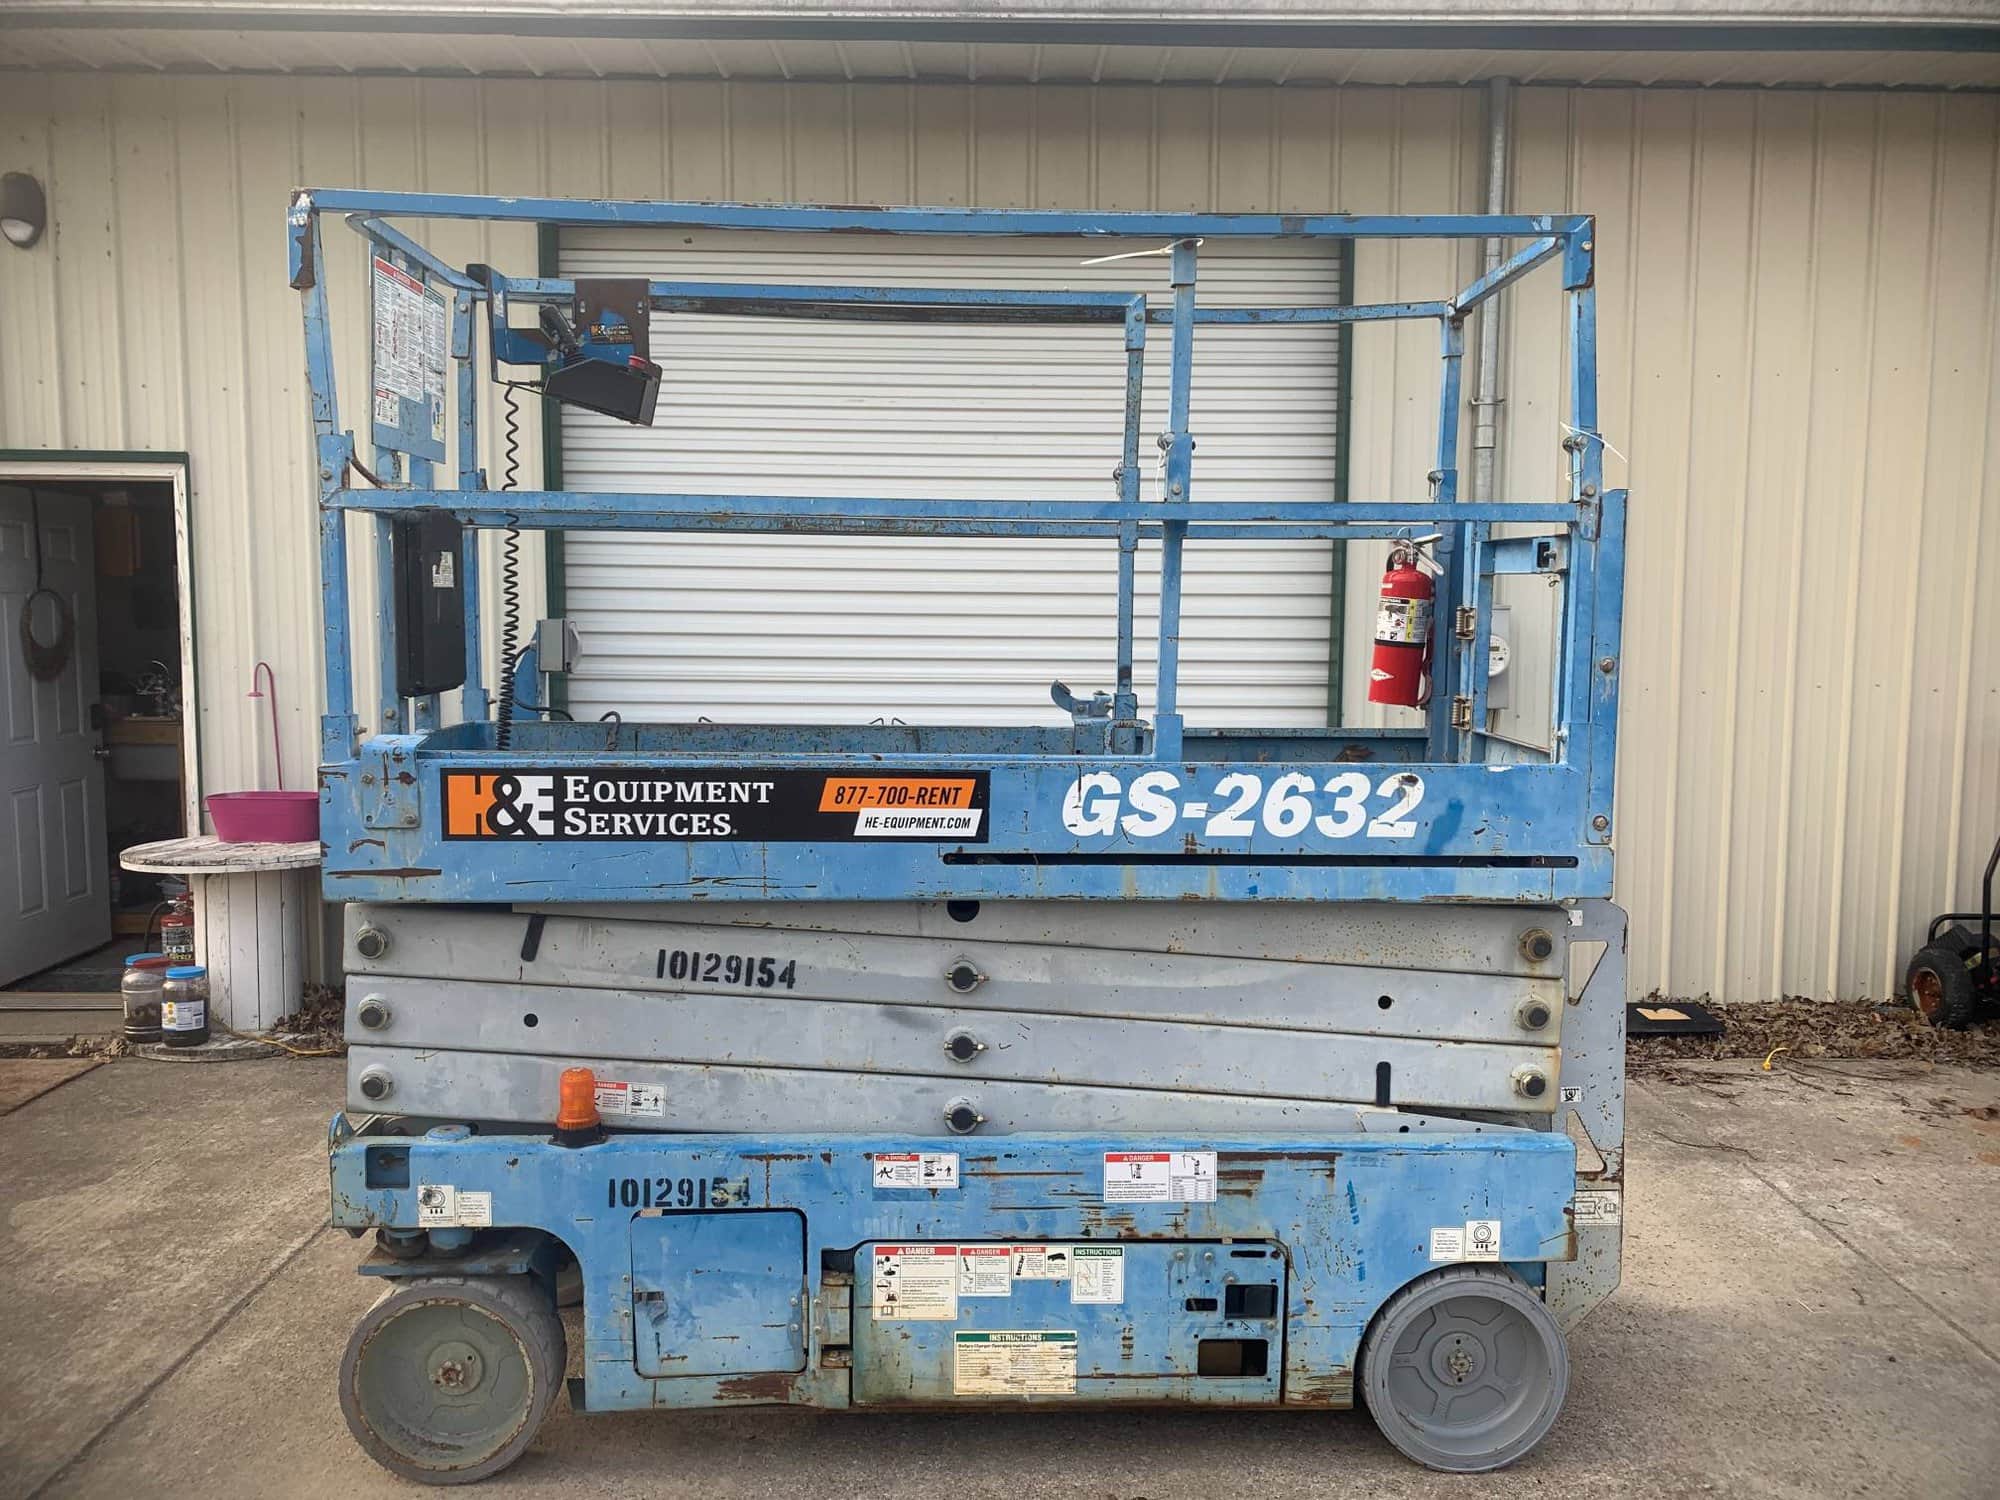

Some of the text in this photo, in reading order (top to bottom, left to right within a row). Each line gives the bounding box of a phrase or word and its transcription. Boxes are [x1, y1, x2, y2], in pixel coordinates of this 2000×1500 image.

[563, 776, 775, 803] EQUIPMENT
[834, 786, 963, 805] 877-700-RENT
[448, 775, 554, 835] H&E
[1062, 771, 1425, 838] GS-2632
[864, 816, 972, 829] HE-EQUIPMENT.COM
[656, 949, 797, 989] 10129154
[905, 1247, 936, 1255] DANGER
[976, 1248, 1001, 1256] DANGER
[1075, 1247, 1122, 1257] INSTRUCTIONS
[989, 1333, 1042, 1342] INSTRUCTIONS
